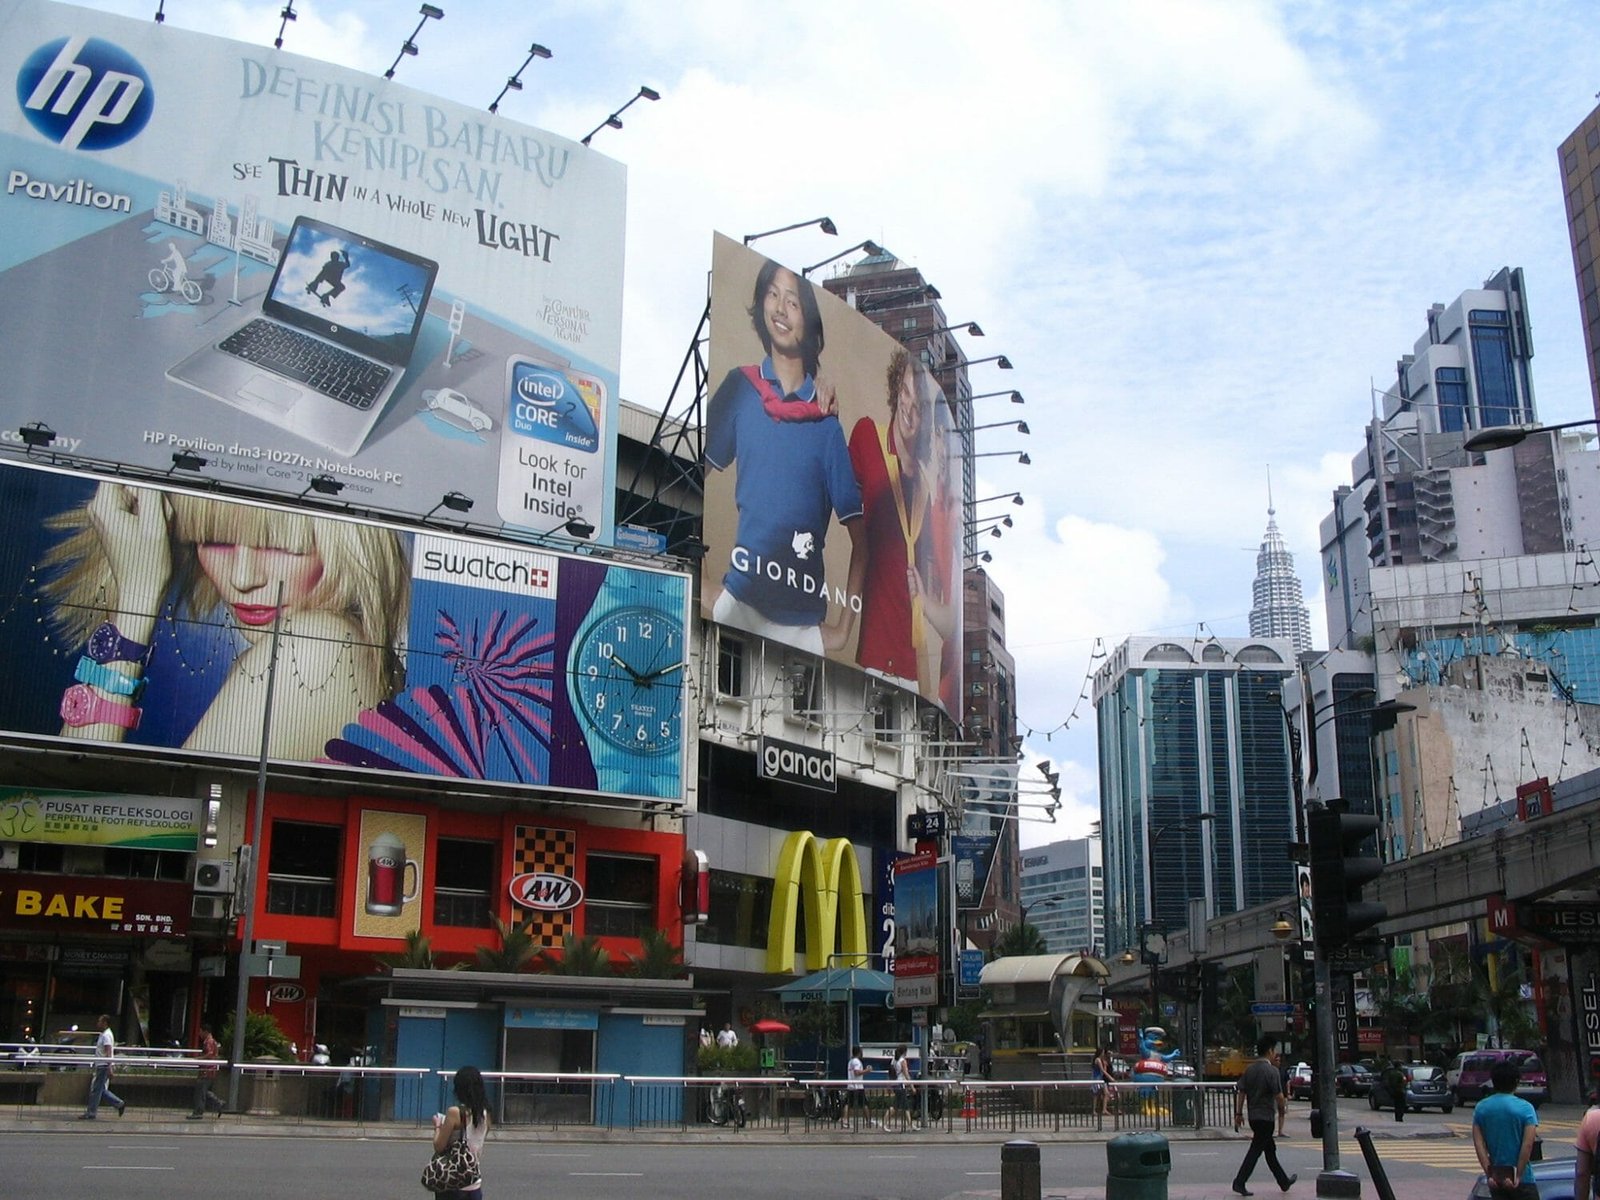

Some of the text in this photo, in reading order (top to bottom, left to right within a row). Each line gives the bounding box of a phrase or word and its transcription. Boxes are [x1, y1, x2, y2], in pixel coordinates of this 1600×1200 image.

[25, 36, 144, 149] hp
[240, 57, 570, 188] DEFINISI BAHARU
[7, 171, 131, 212] Pavilion
[233, 156, 560, 263] SEE THIN IN A WHOLE NEW LIGHT
[515, 420, 532, 431] Duo
[143, 430, 165, 445] HP
[168, 434, 225, 454] Pavilion
[228, 442, 312, 468] dm3-1027tx
[316, 459, 382, 481] Notebook
[384, 471, 403, 485] PC
[221, 460, 233, 472] by
[519, 447, 587, 480] Look for
[532, 473, 572, 498] Intel
[424, 551, 529, 585] swatch
[731, 547, 862, 613] GIORDANO
[617, 626, 627, 643] 11
[638, 622, 652, 639] 12
[598, 643, 614, 659] 10
[588, 666, 598, 682] 9
[595, 693, 605, 709] 8
[612, 715, 622, 730] 7
[660, 721, 670, 737] 5
[636, 724, 648, 741] 6
[764, 746, 835, 783] ganad
[46, 802, 193, 821] PUSAT REFLEKSOLOGI
[45, 813, 192, 830] PERPETUAL FOOT REFLEXOLOGY
[926, 817, 939, 829] 24
[523, 880, 572, 903] A&W
[15, 889, 125, 920] BAKE
[1494, 908, 1508, 927] M
[801, 992, 823, 1000] POLIS
